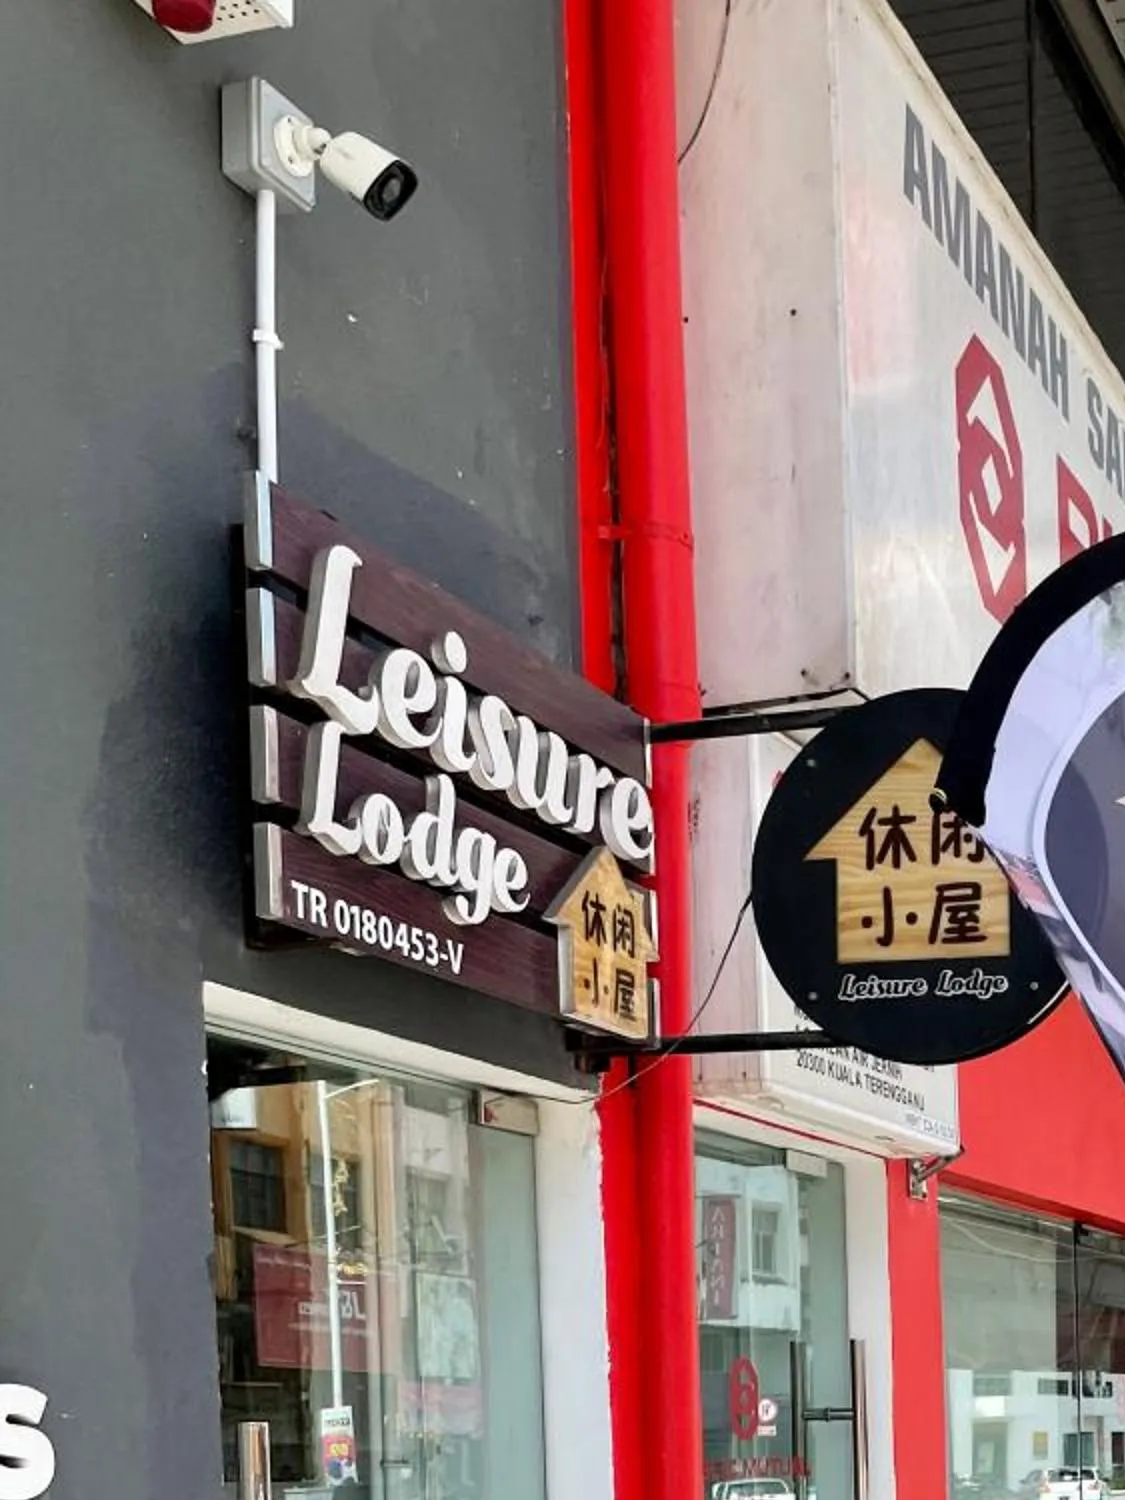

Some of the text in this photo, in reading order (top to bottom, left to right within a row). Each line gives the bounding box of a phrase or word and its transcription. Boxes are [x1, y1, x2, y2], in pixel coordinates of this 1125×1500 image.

[903, 103, 1071, 424] AMANAH
[289, 545, 654, 860] Leisure
[309, 722, 531, 925] Lodge
[291, 881, 465, 976] TR 0180453-V
[581, 891, 637, 959] 休闲
[860, 881, 988, 947] 小屋
[583, 970, 637, 1020] 小屋
[838, 968, 1009, 1000] Leisure Lodge
[828, 1058, 862, 1088] KUALA
[864, 1073, 925, 1111] TERENGGANU
